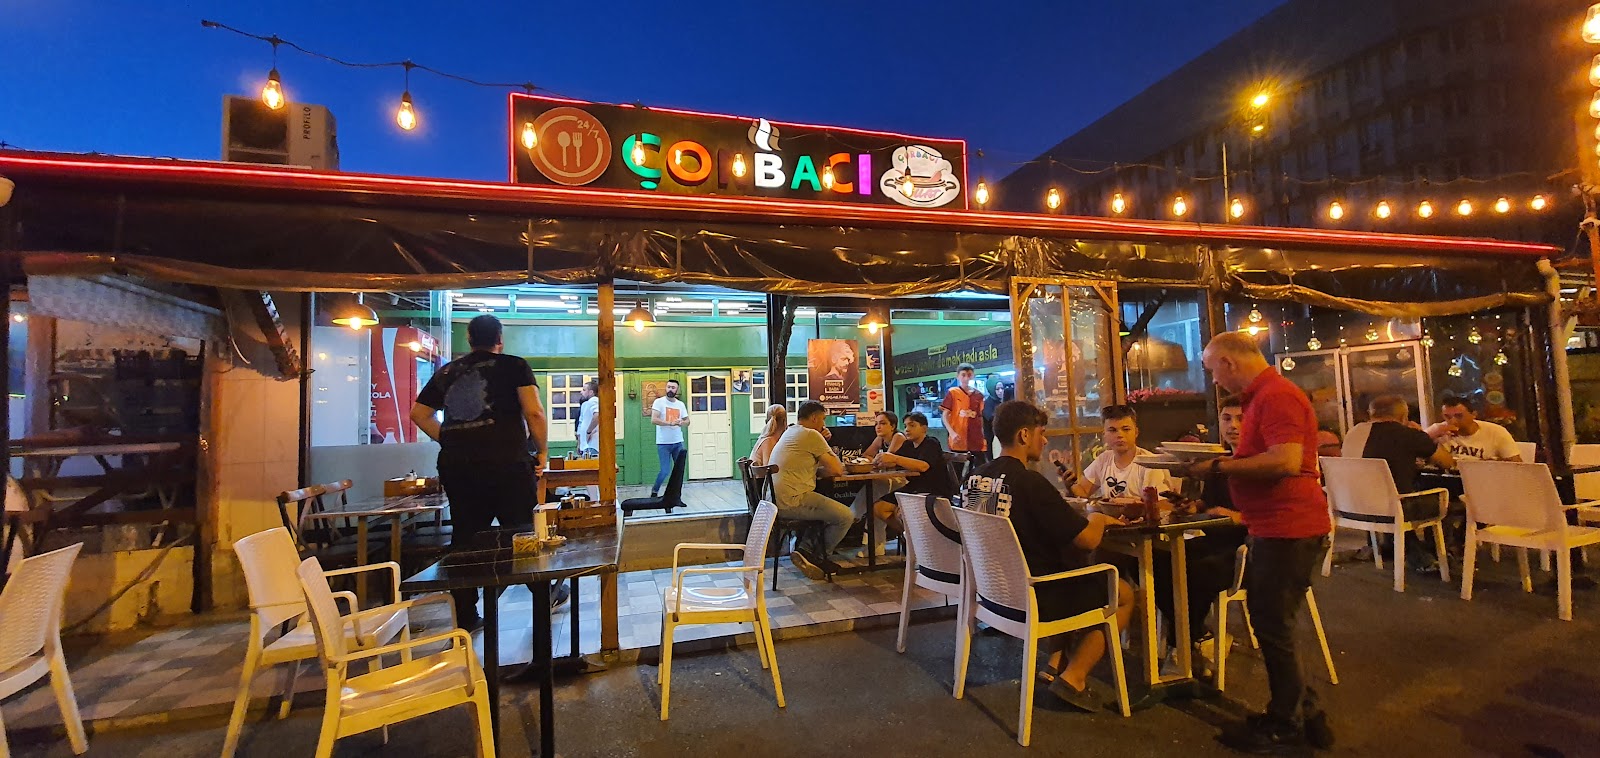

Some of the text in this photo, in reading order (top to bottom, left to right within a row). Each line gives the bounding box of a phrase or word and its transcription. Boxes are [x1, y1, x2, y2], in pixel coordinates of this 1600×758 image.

[577, 119, 600, 139] 24/7
[978, 343, 998, 362] asla
[371, 391, 391, 399] OLA
